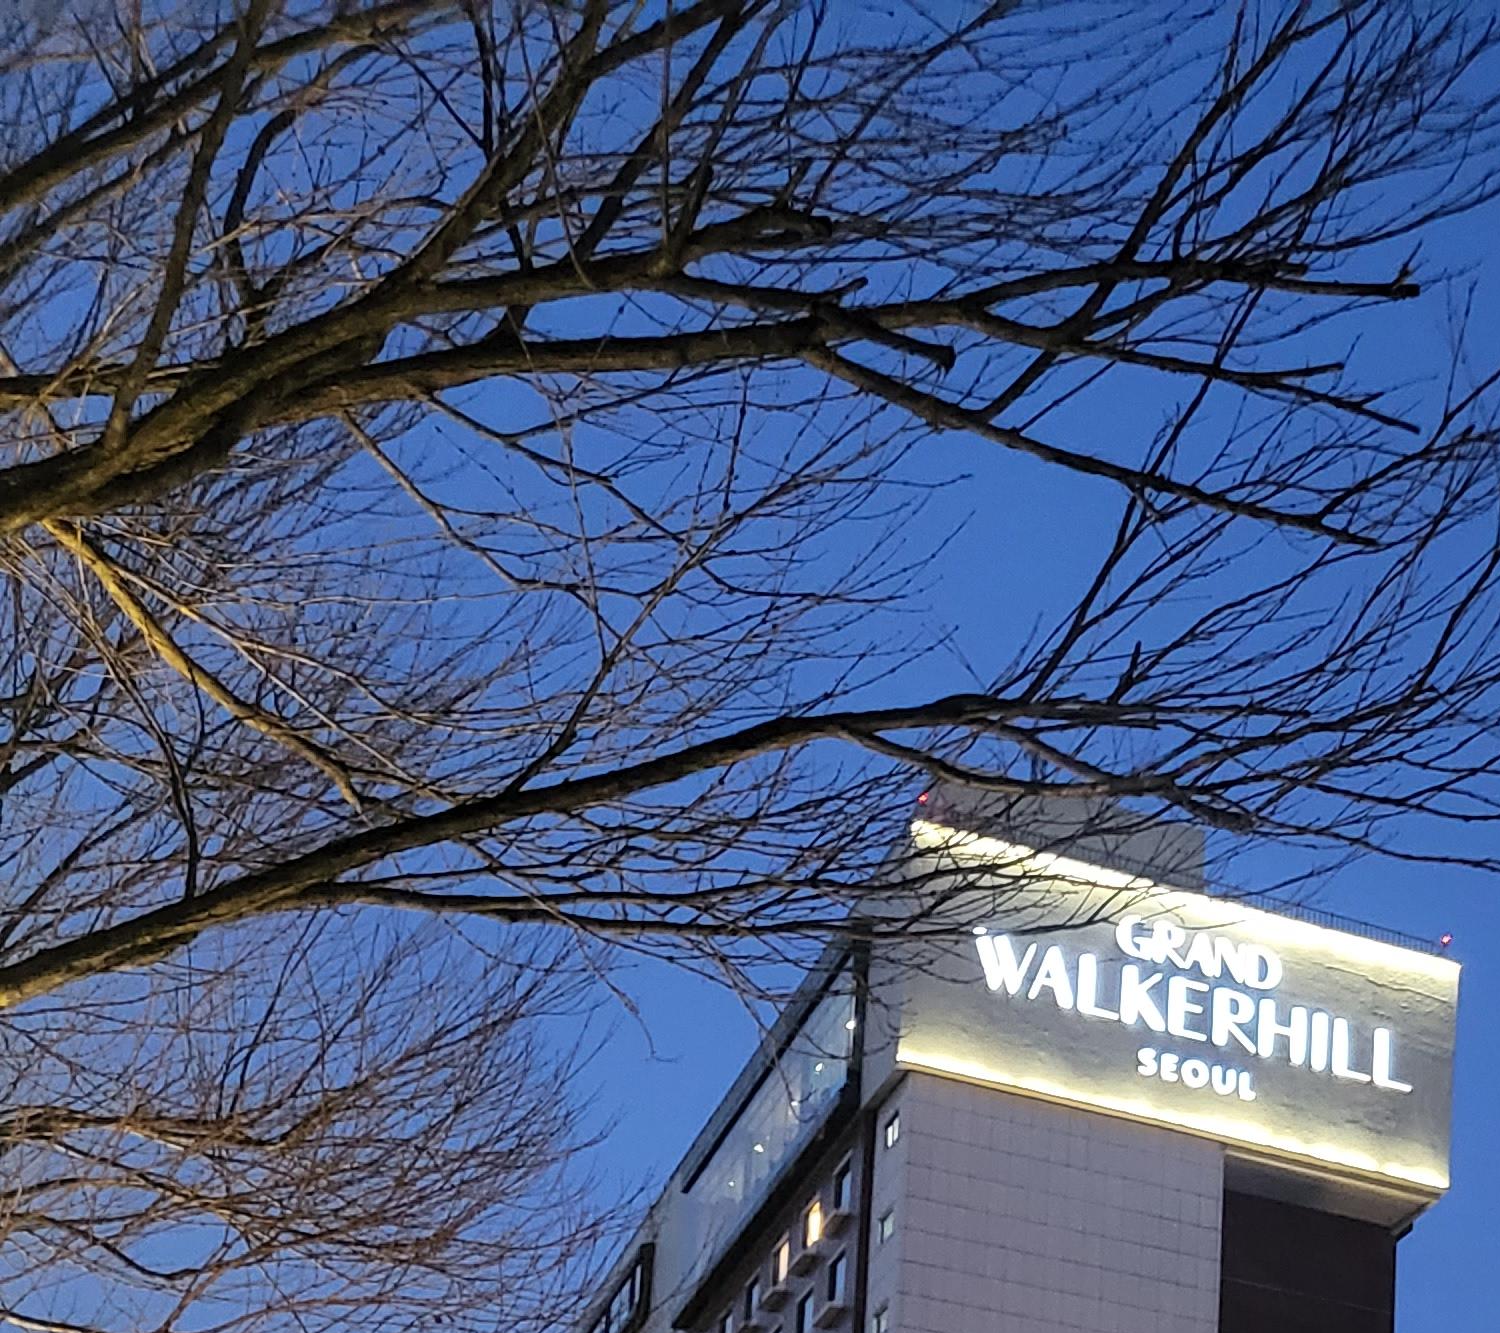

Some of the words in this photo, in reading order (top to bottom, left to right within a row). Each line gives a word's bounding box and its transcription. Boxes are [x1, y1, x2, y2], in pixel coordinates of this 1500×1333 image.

[1115, 914, 1283, 990] GRAND
[972, 926, 1413, 1093] WALKERHILL
[1136, 1047, 1256, 1101] SEOUL
